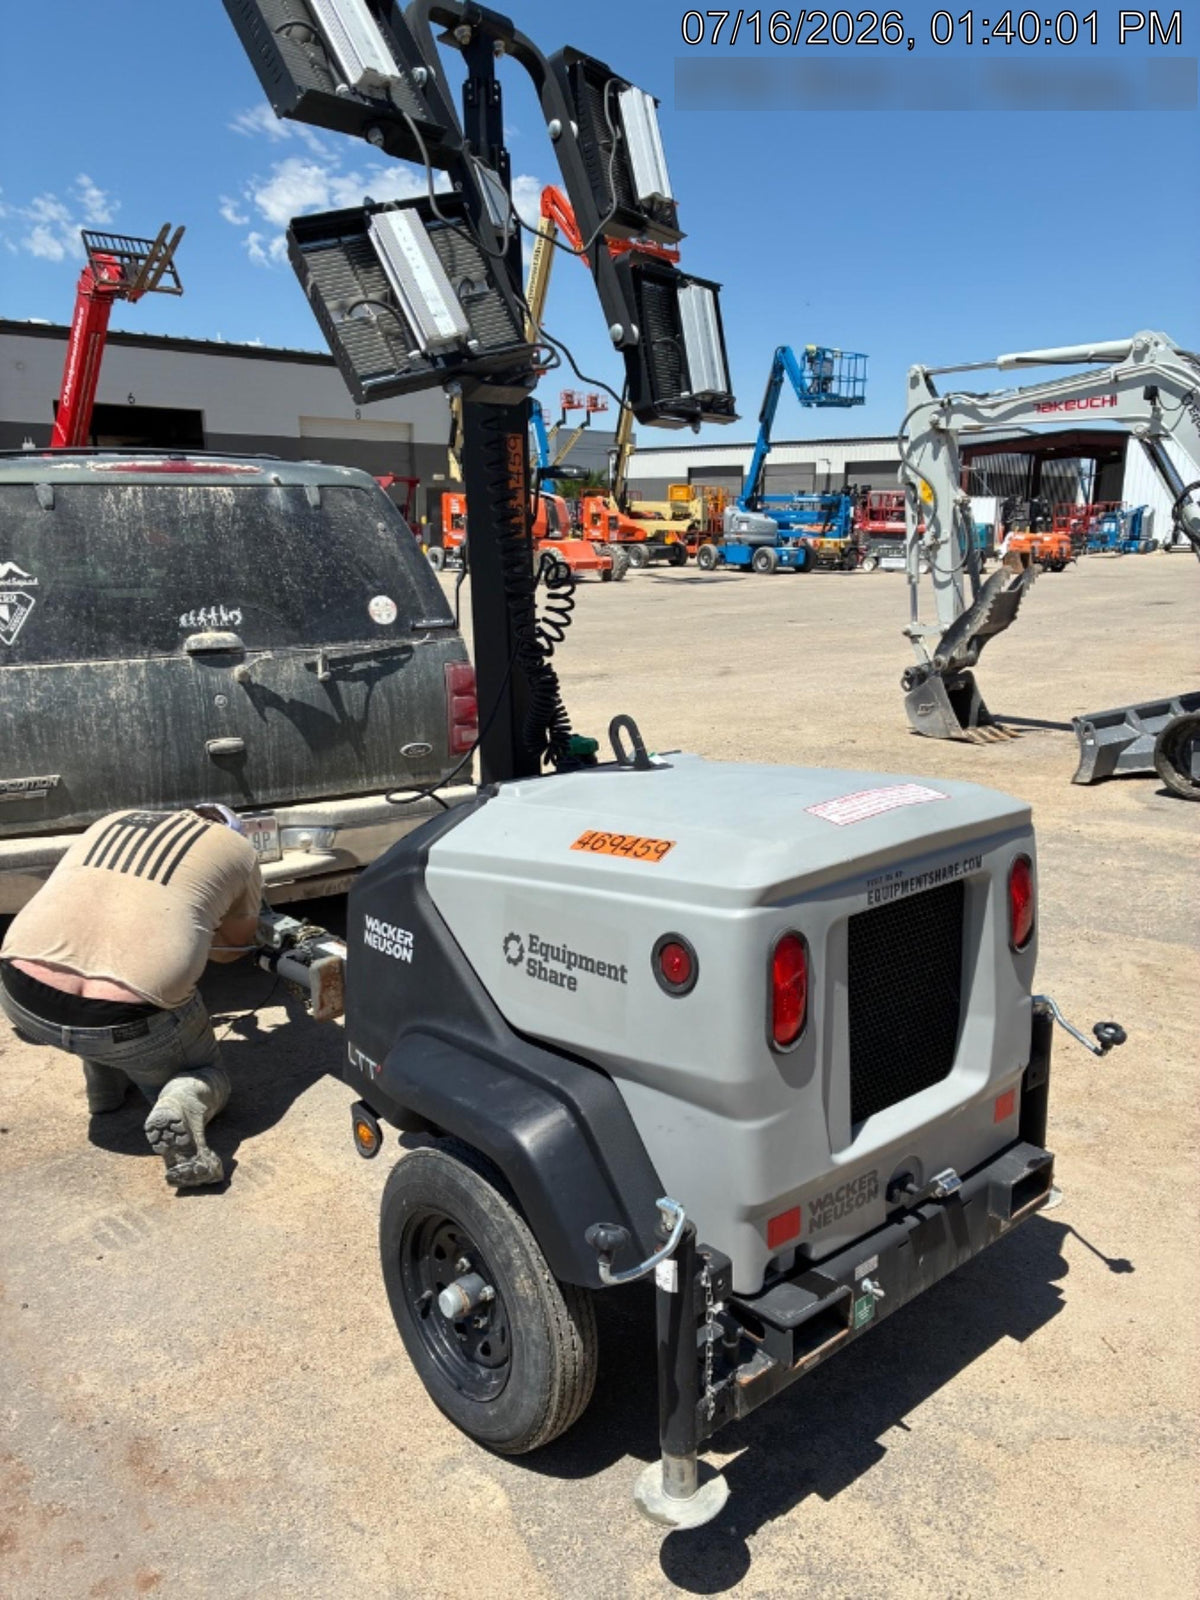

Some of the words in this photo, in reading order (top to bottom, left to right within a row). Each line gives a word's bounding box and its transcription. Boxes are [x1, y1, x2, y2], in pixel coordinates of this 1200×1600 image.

[577, 831, 672, 861] 469459
[867, 855, 983, 905] EQUIPMENTSHARE.COM
[364, 914, 414, 948] WACKER
[364, 929, 413, 964] NEUSON
[526, 957, 578, 992] Share
[528, 933, 628, 984] Equipment
[807, 1169, 878, 1216] WACKER
[808, 1183, 879, 1235] NEUSON
